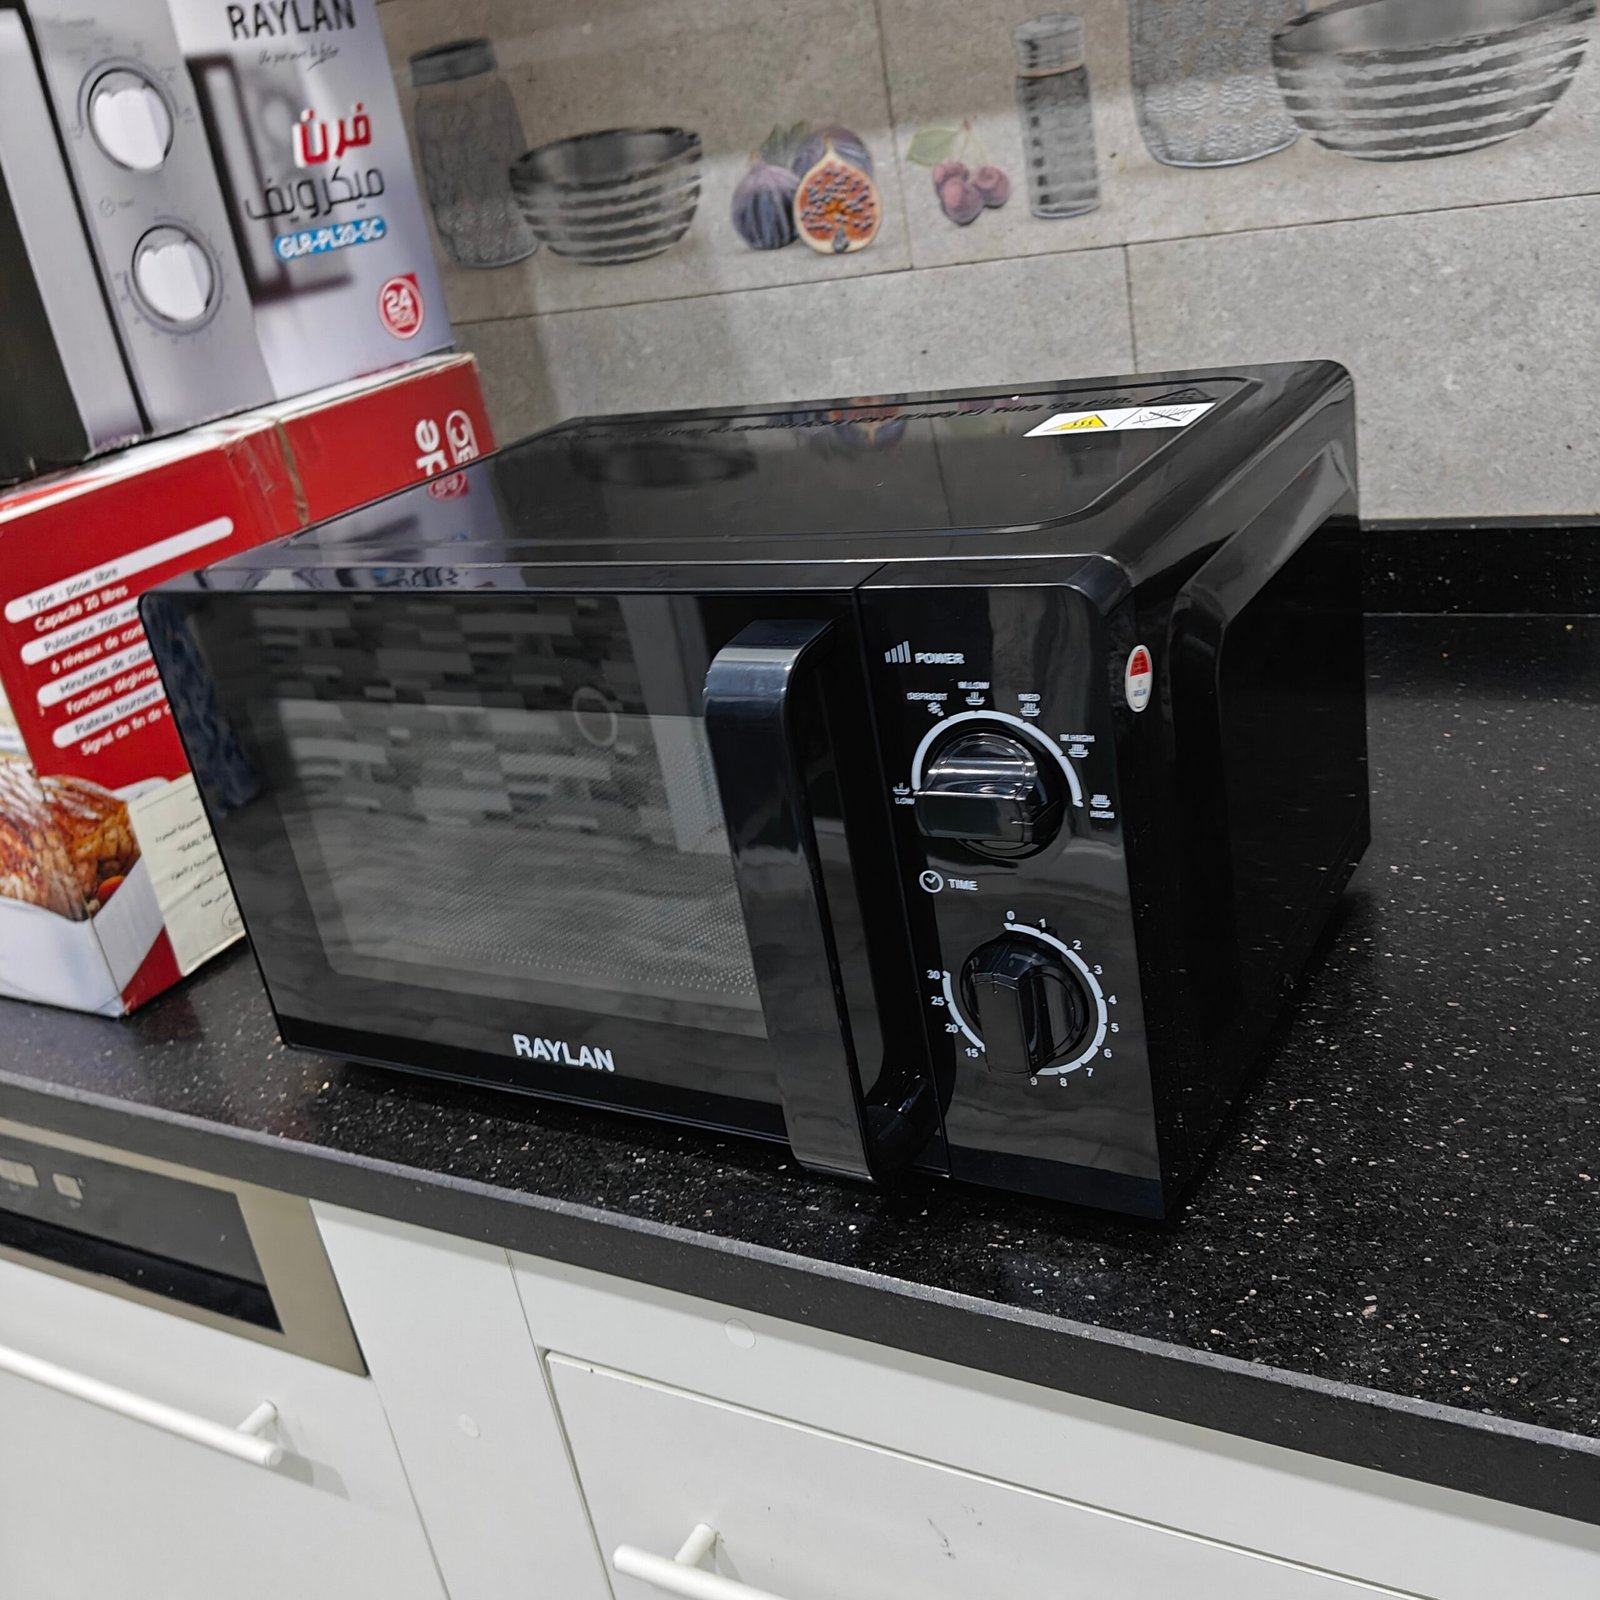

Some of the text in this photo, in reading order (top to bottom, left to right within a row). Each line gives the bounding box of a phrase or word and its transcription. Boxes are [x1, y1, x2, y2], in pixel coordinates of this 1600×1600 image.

[226, 0, 356, 40] RAYLAN
[296, 101, 372, 167] فرن
[245, 166, 385, 222] ميكرويف
[385, 288, 413, 312] 24
[914, 652, 965, 665] POWER
[894, 797, 915, 805] LOW
[948, 878, 979, 891] TIME
[1006, 910, 1015, 920] 0
[1039, 918, 1046, 928] 1
[1072, 940, 1082, 950] 2
[926, 970, 941, 980] 30
[1094, 965, 1103, 975] 3
[931, 996, 945, 1006] 25
[1108, 995, 1117, 1004] 4
[945, 1024, 959, 1034] 20
[1111, 1023, 1119, 1033] 5
[512, 1033, 615, 1072] RAYLAN
[965, 1048, 979, 1058] 15
[1104, 1049, 1112, 1058] 6
[1085, 1068, 1094, 1077] 7
[1030, 1077, 1038, 1086] 9
[1059, 1078, 1068, 1087] 8
